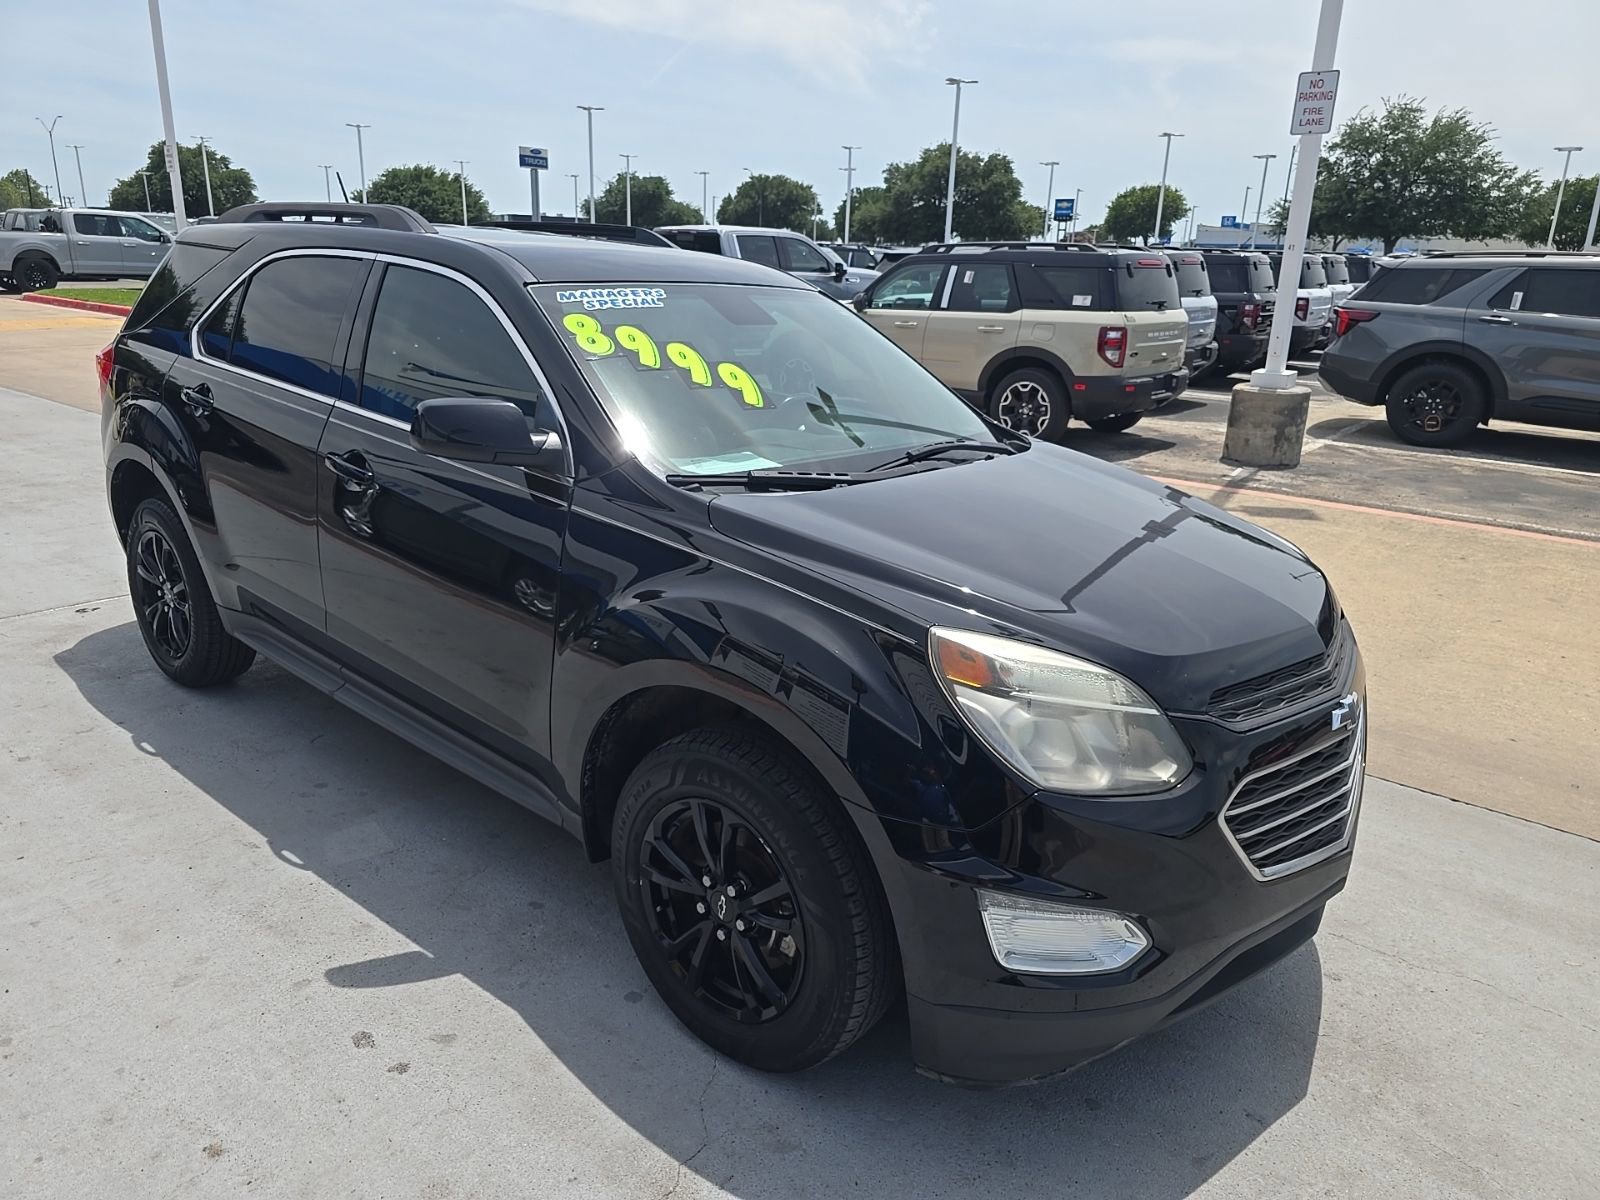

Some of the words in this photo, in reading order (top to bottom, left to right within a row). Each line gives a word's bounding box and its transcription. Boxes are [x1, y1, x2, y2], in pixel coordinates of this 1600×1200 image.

[1309, 79, 1325, 89] NO
[1299, 91, 1333, 102] PARKING
[1303, 107, 1325, 116] FIRE
[1299, 118, 1325, 127] LANE
[559, 289, 664, 301] MANAGERS
[585, 297, 661, 309] SPECIAL
[562, 313, 764, 408] 8999
